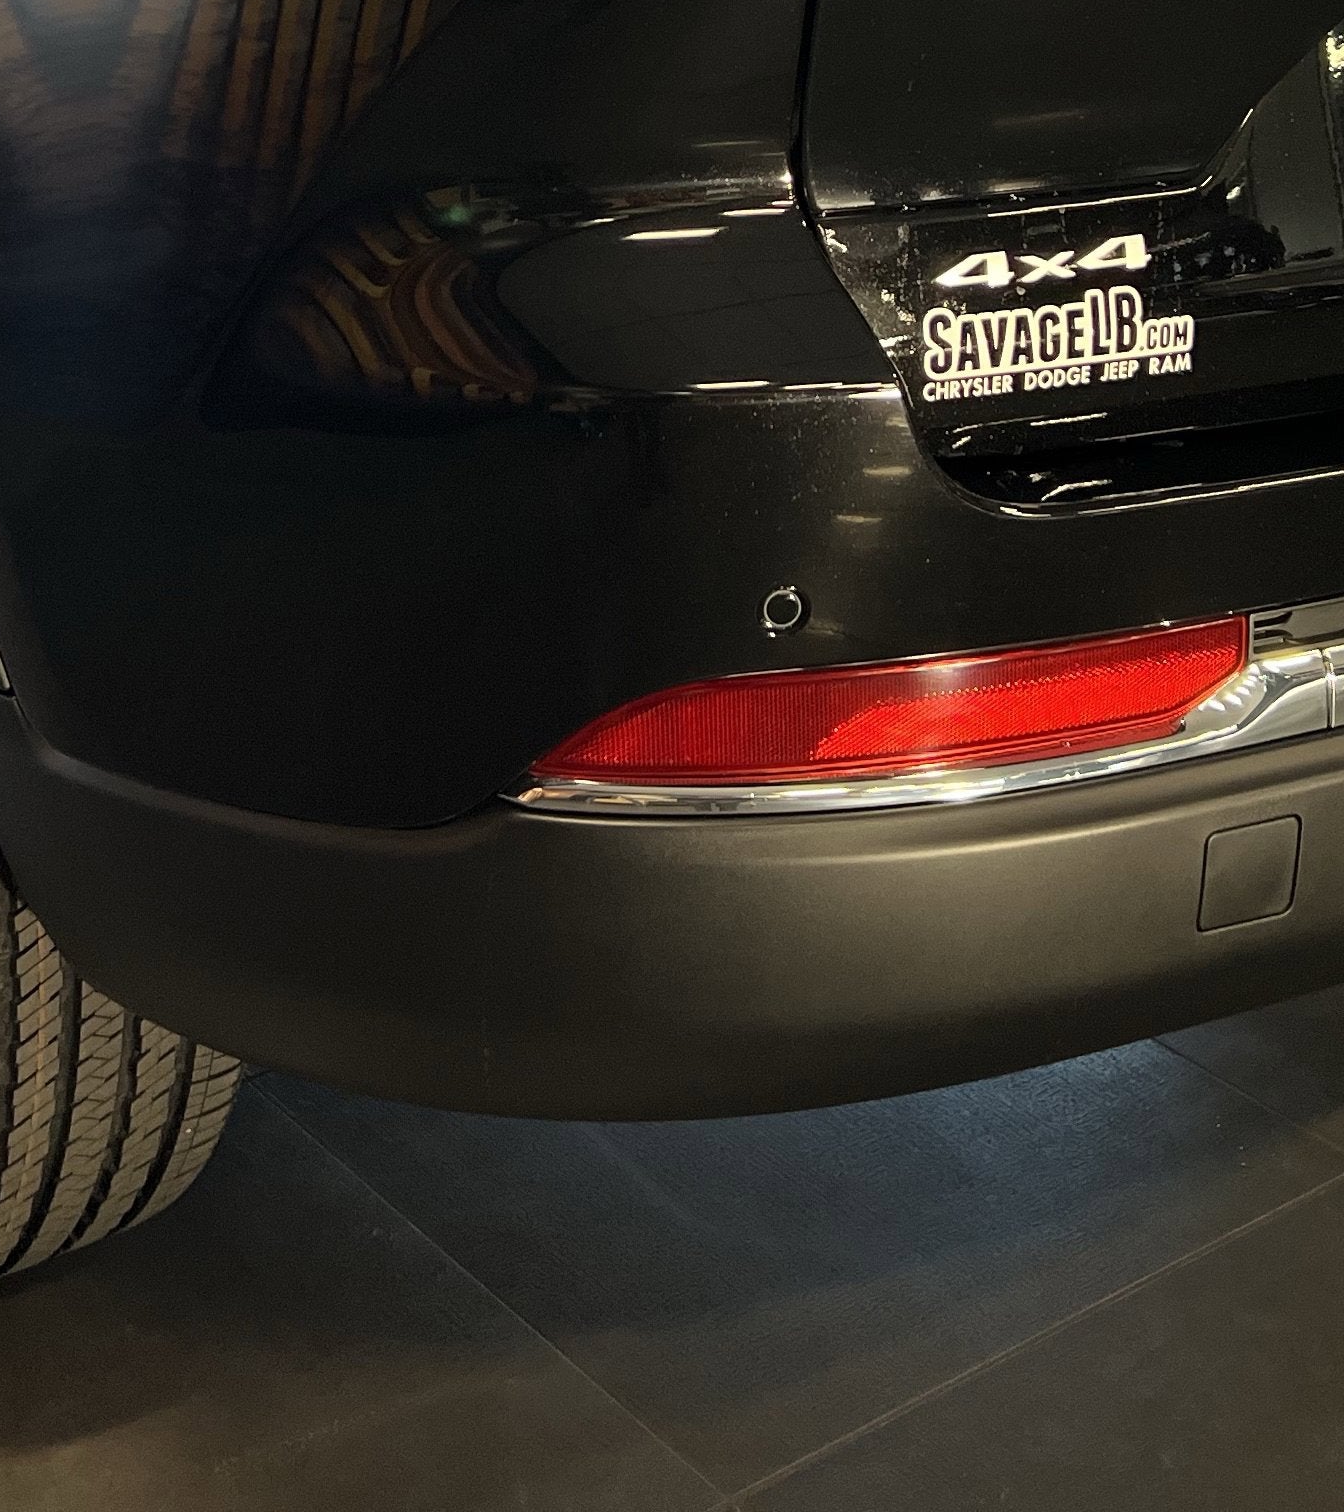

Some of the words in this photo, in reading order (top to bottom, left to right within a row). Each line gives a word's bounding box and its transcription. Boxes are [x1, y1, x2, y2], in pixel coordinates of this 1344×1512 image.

[931, 233, 1153, 288] 4x4
[922, 375, 1014, 402] CHRYSLER
[1023, 365, 1092, 391] DODGE
[1099, 359, 1139, 382] JEEP
[1148, 353, 1192, 376] RAM
